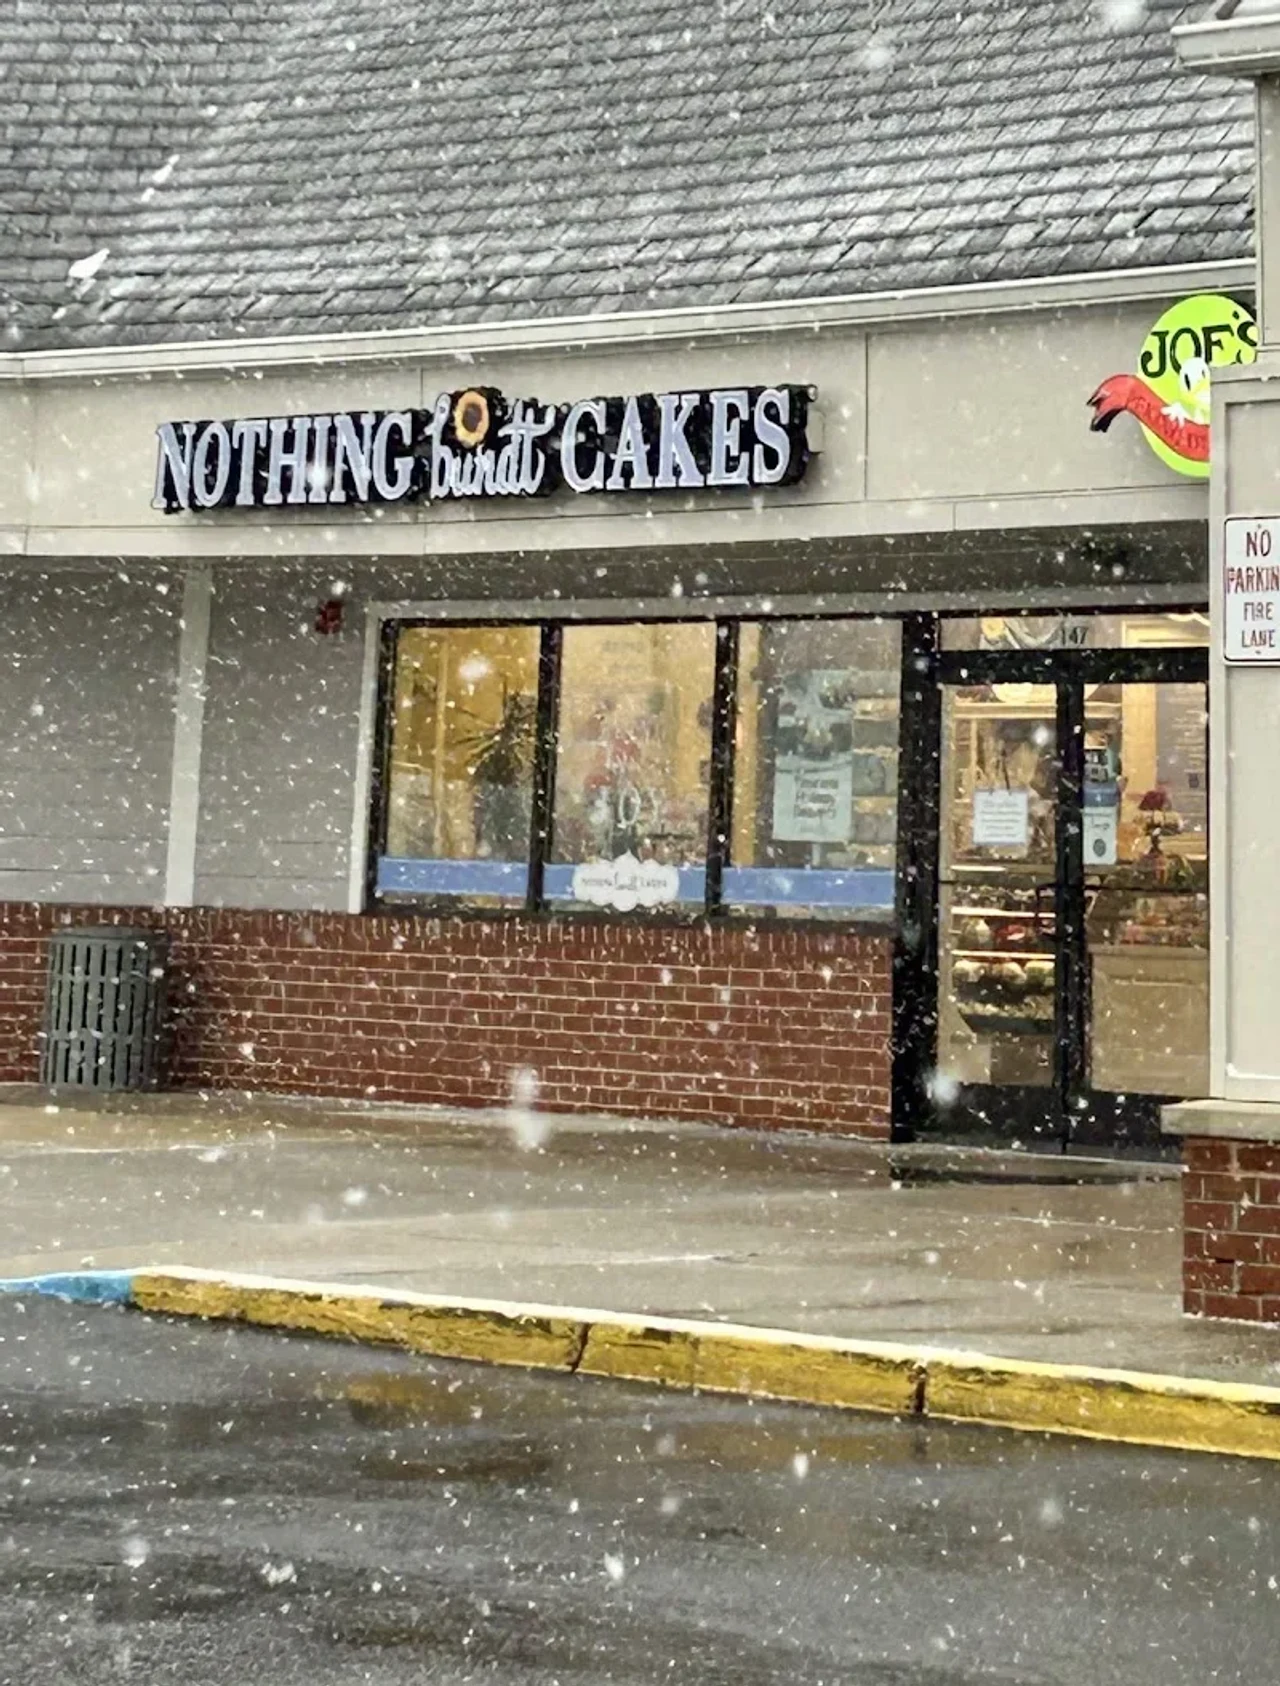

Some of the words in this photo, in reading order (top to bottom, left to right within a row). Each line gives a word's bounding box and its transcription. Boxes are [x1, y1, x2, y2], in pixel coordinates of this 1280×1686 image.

[153, 413, 413, 509] NOTHING
[424, 392, 556, 498] bundt
[560, 388, 792, 493] CAKES
[1246, 529, 1272, 557] NO
[1227, 565, 1280, 594] PARKIN
[1243, 601, 1274, 621] FIRE
[1241, 630, 1275, 648] LANE
